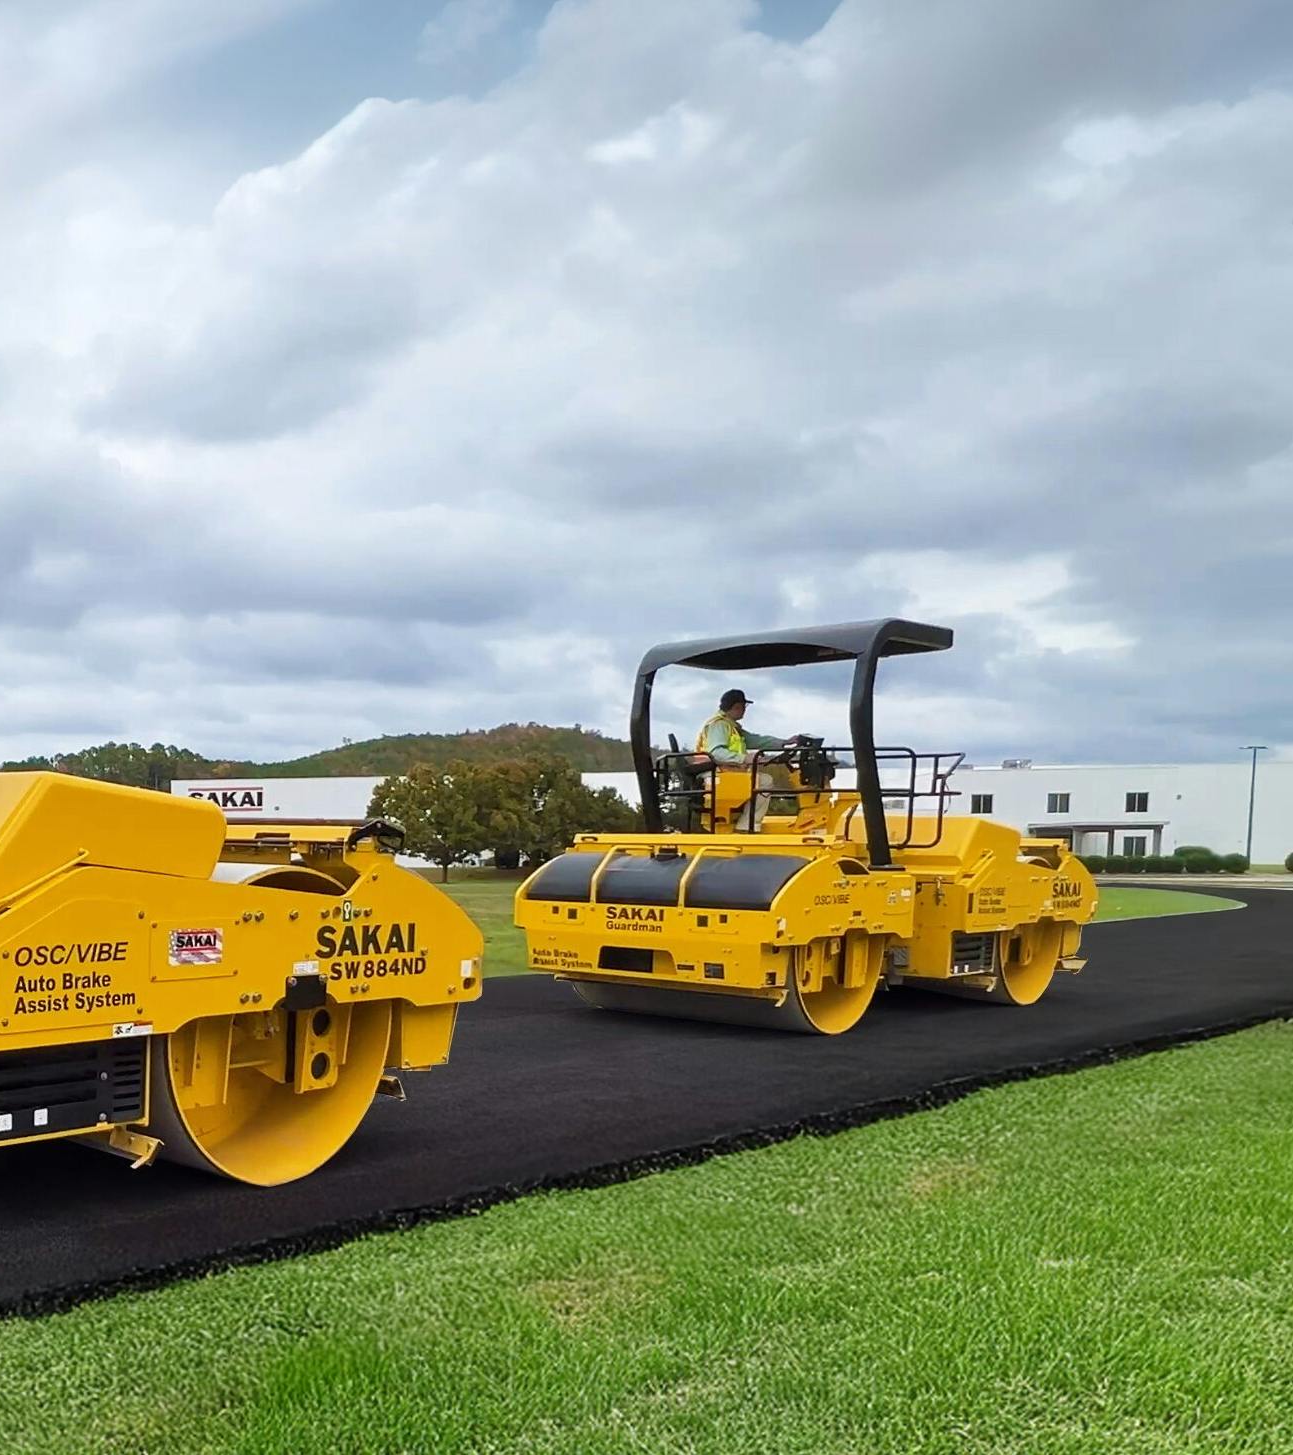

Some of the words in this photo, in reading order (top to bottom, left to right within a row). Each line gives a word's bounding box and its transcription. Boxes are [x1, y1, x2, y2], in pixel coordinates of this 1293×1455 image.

[1052, 881, 1081, 898] SAKAI
[606, 906, 665, 921] SAKAI
[606, 920, 663, 933] Guardman
[176, 934, 217, 948] SAKAI
[314, 922, 416, 958] SAKAI
[14, 941, 129, 967] OSC/VIBE
[14, 975, 56, 994] Auto
[62, 971, 112, 990] Brake
[14, 994, 70, 1015] Assist
[75, 991, 136, 1013] System
